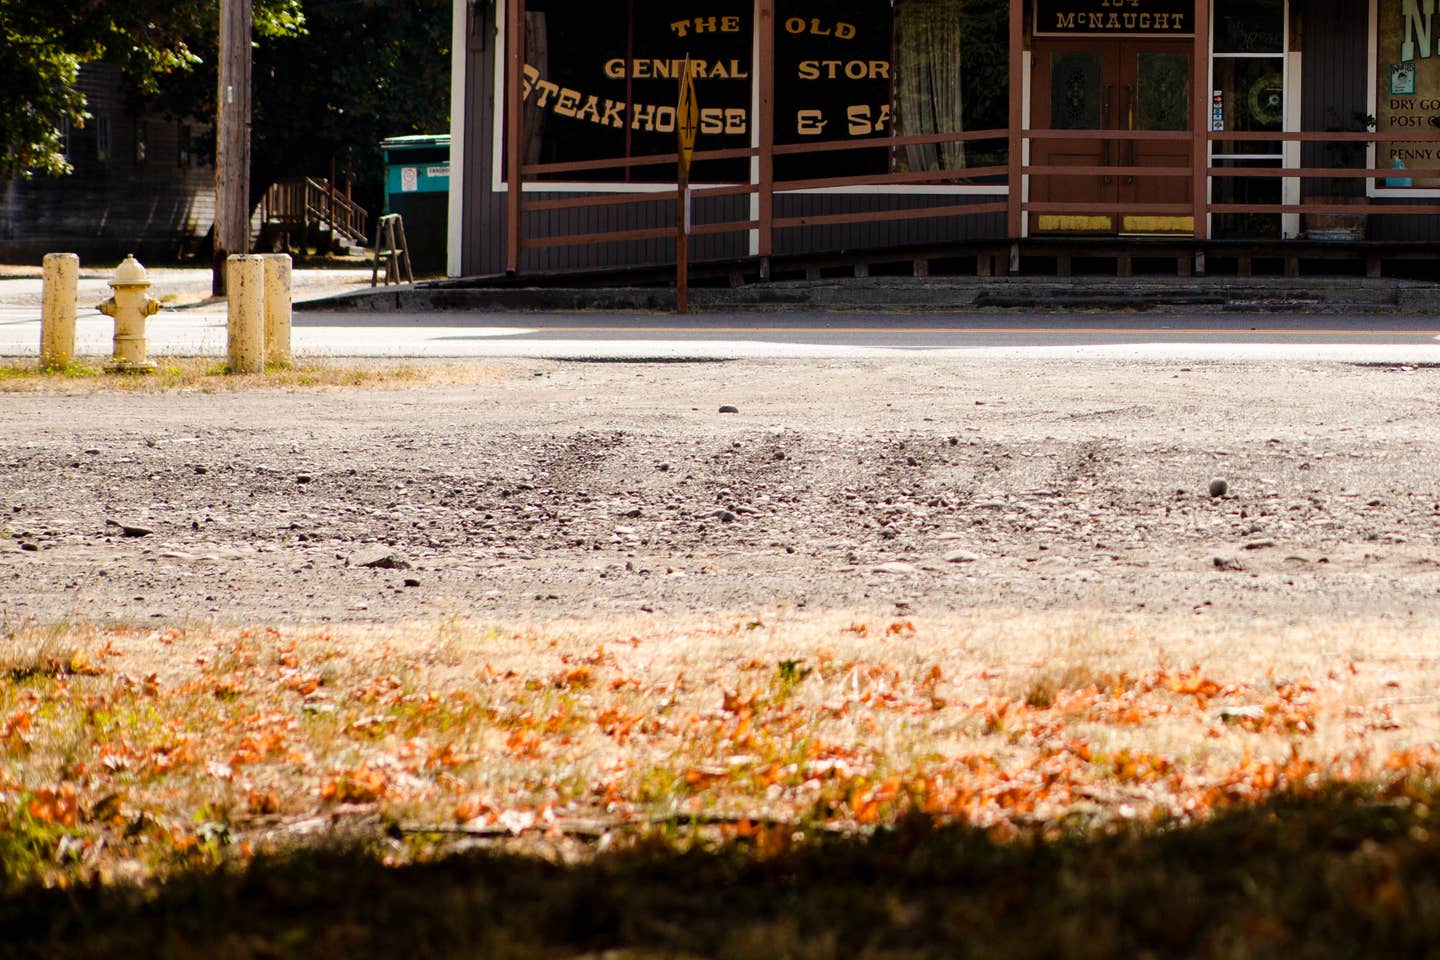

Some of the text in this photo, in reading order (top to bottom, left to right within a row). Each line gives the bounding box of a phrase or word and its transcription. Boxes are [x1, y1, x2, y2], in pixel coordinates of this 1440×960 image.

[670, 15, 857, 40] THE OLD
[604, 58, 748, 80] GENERAL
[522, 63, 747, 135] STEAKHOSE
[797, 108, 829, 135] &
[1391, 99, 1416, 110] DRY
[1391, 116, 1424, 127] POST
[1390, 149, 1432, 160] PENNY
